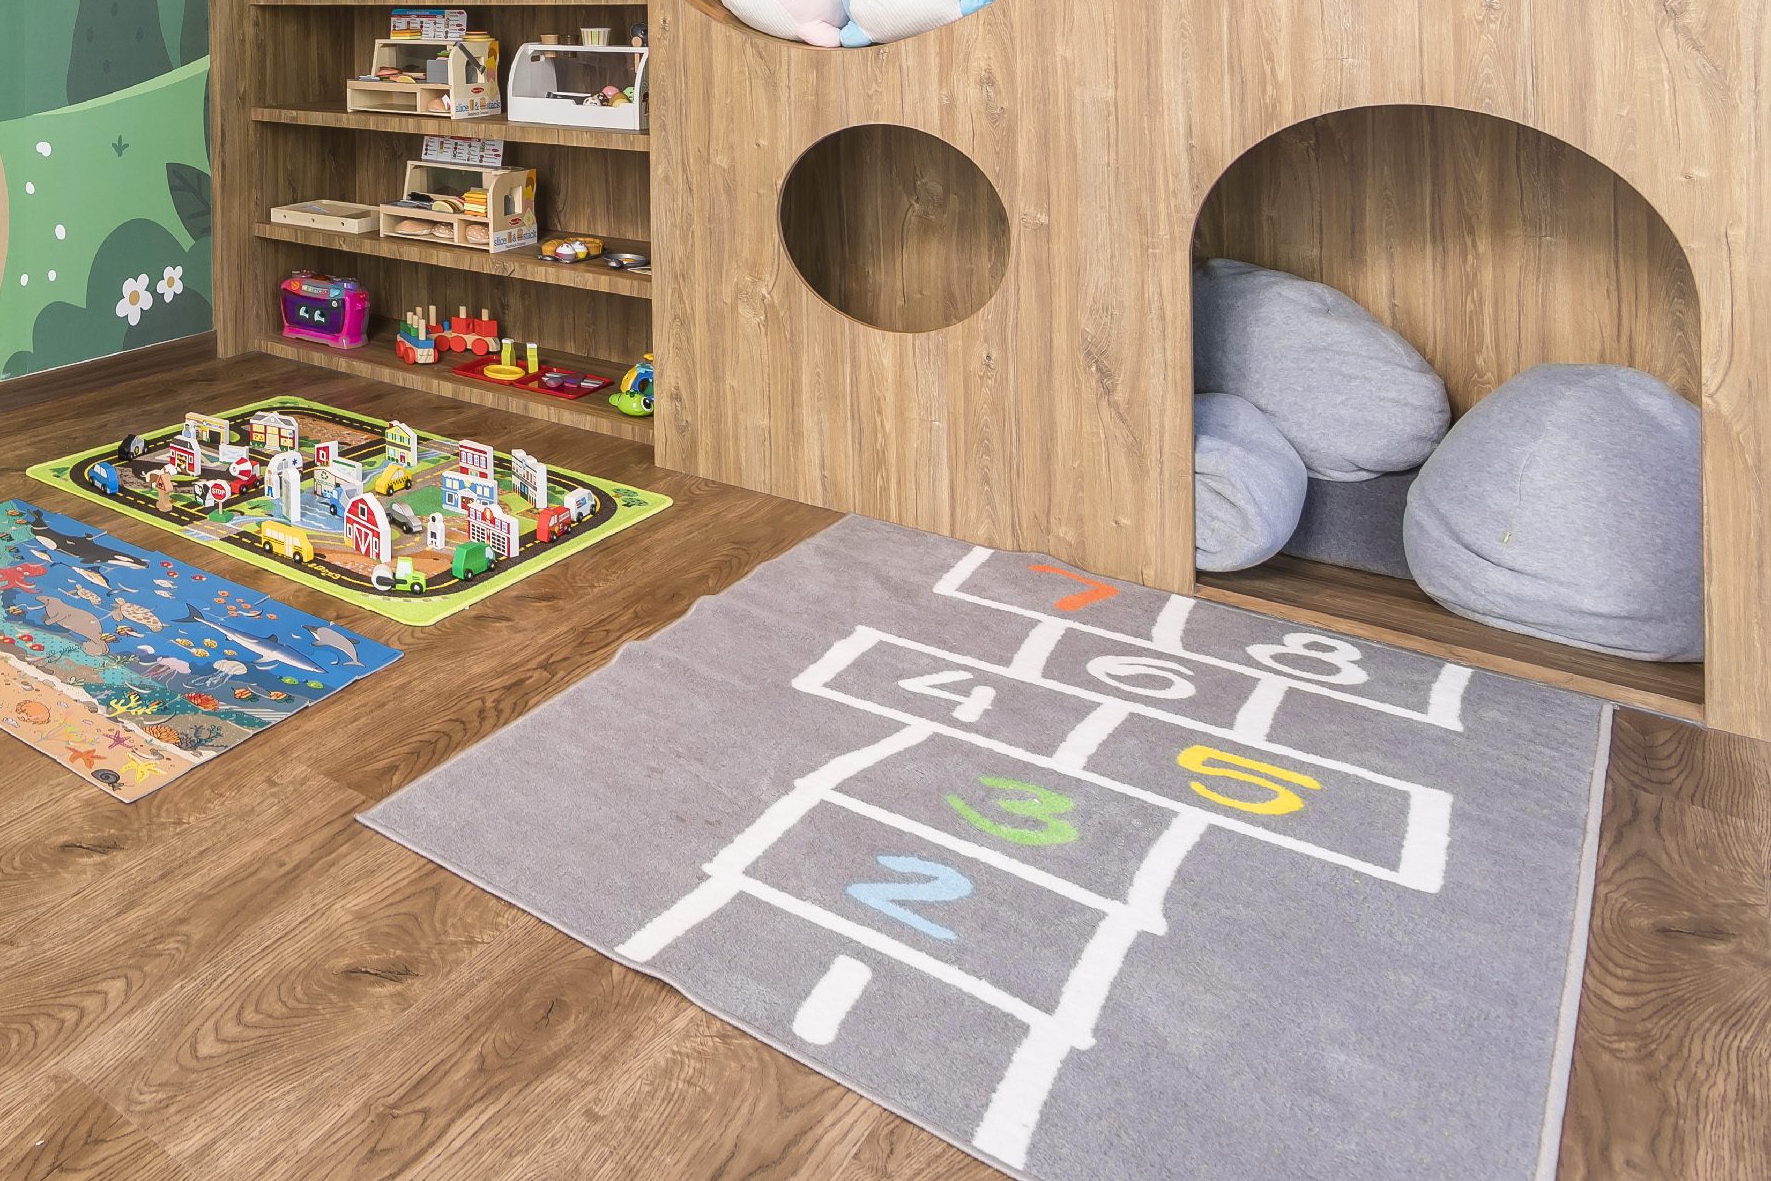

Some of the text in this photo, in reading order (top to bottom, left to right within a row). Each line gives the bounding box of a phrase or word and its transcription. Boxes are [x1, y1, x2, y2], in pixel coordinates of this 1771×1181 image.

[211, 487, 226, 496] STOP
[1029, 565, 1120, 612] 7
[1085, 654, 1197, 700] 6
[1246, 631, 1369, 687] 8
[897, 669, 994, 723] 4
[1177, 744, 1323, 816] 5
[944, 775, 1080, 846] 3
[846, 854, 976, 941] 2
